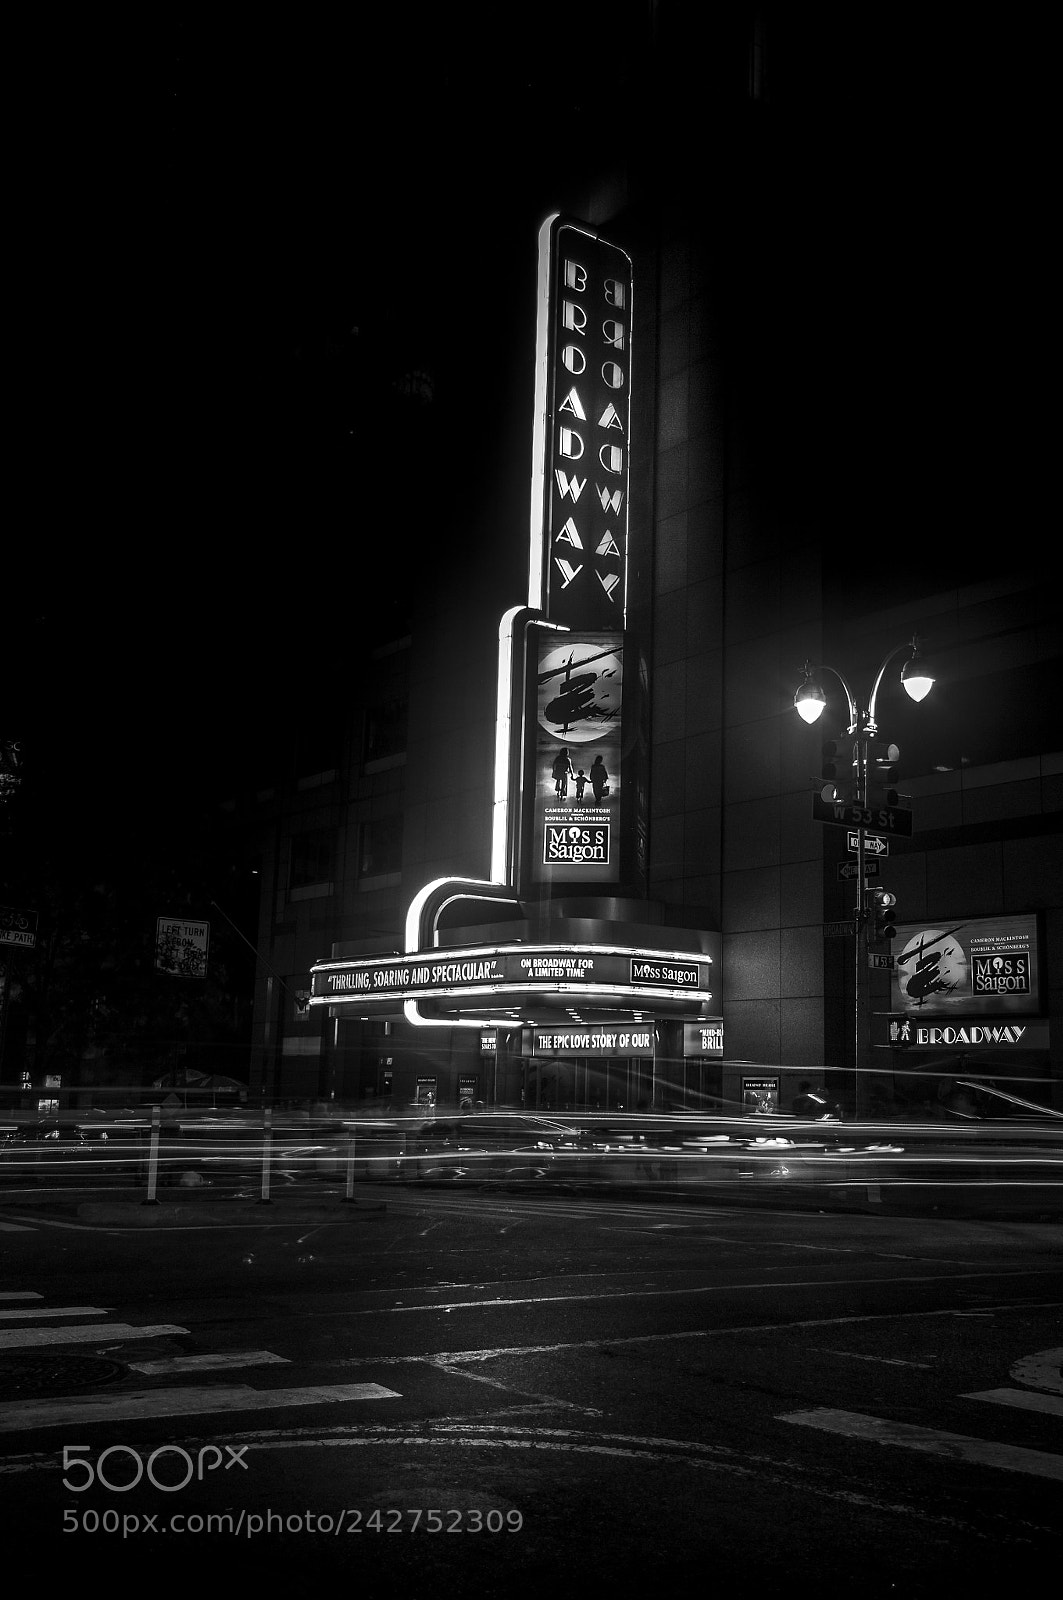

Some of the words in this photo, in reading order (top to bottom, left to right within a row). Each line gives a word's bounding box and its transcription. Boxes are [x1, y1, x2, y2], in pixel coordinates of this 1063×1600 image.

[554, 258, 588, 590] BROADWAY
[833, 806, 846, 820] W
[852, 807, 873, 824] 53
[878, 810, 895, 828] St
[549, 827, 604, 844] Miss
[549, 842, 605, 863] Saigon
[14, 932, 33, 943] PATH
[184, 926, 204, 936] TURN
[521, 959, 533, 969] ON
[533, 958, 577, 969] BROADWAY
[578, 958, 594, 969] FOR
[975, 957, 1025, 976] Miss
[373, 969, 409, 988] SOARING
[411, 966, 429, 985] AND
[527, 968, 534, 977] A
[535, 968, 564, 978] LIMITED
[565, 968, 585, 978] TIME
[633, 964, 661, 979] Miss
[662, 967, 698, 983] Saigon
[975, 974, 1028, 994] Saigon
[539, 1035, 553, 1049] THE
[553, 1035, 570, 1048] EPIC
[570, 1035, 591, 1049] LOVE
[592, 1034, 618, 1049] STORY
[619, 1034, 630, 1048] OF
[632, 1033, 650, 1048] OUR
[916, 1026, 1026, 1044] BROADWAY
